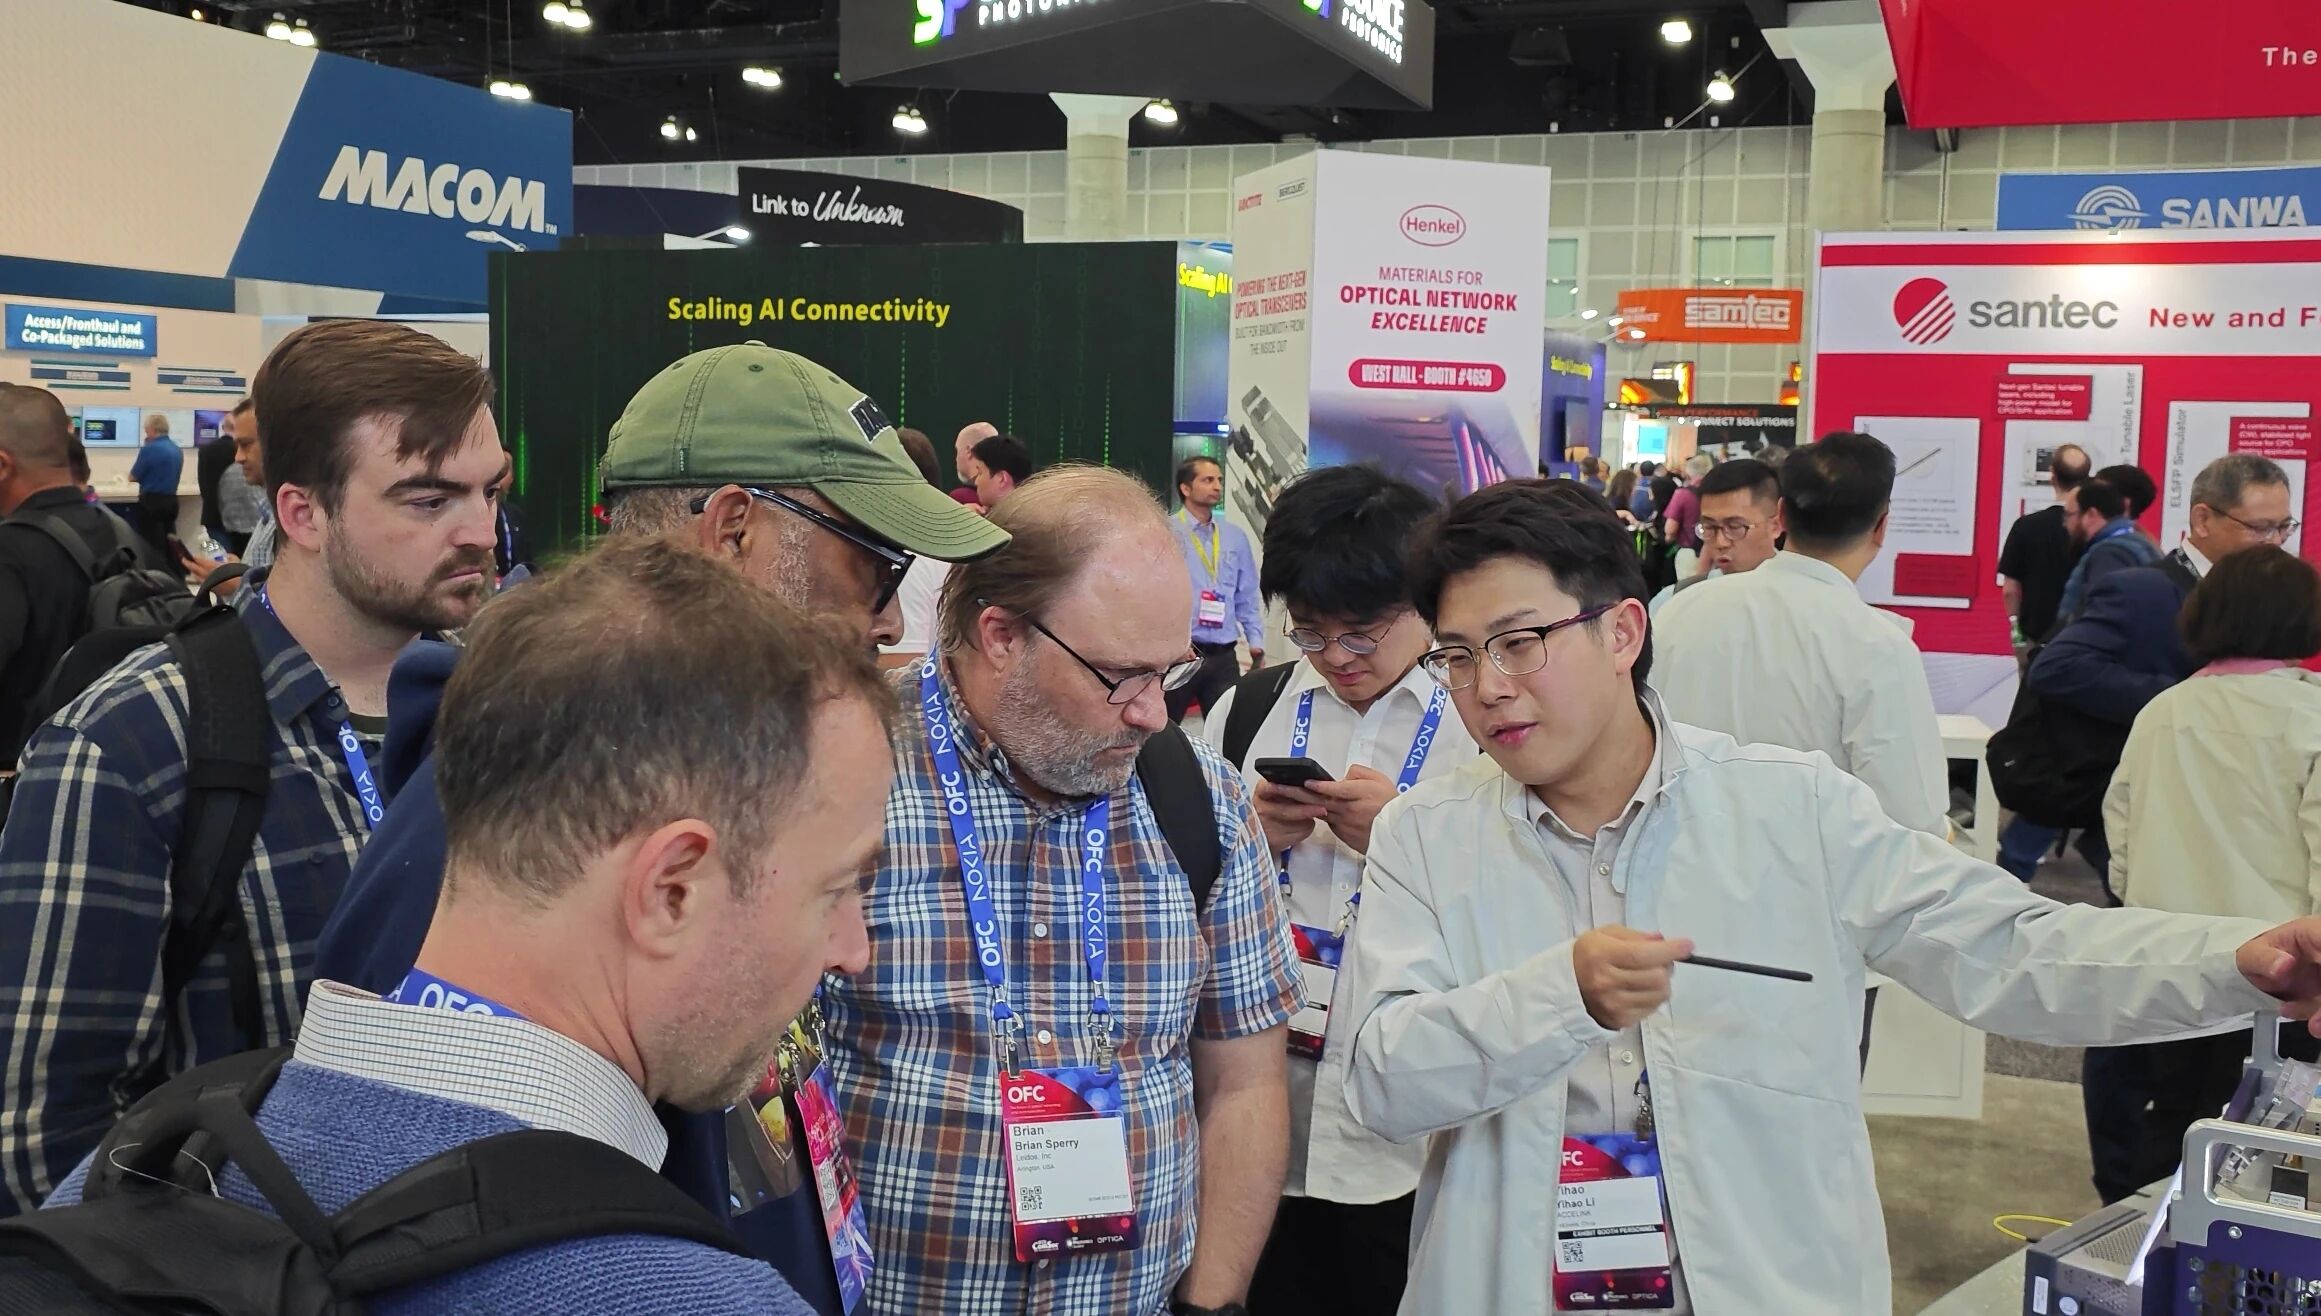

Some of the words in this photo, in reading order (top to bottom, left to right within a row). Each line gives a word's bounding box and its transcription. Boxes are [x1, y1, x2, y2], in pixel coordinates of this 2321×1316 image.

[1341, 6, 1402, 64] PHOTONICS
[2262, 46, 2319, 67] The
[318, 144, 545, 233] MACOM
[752, 193, 788, 215] Link
[791, 198, 809, 217] to
[812, 185, 905, 227] Unknown
[2161, 195, 2307, 229] SANWA
[1406, 216, 1460, 234] Henkel
[1379, 266, 1453, 284] MATERIALS
[1457, 270, 1483, 286] FOR
[1340, 285, 1421, 306] OPTICAL
[1426, 289, 1518, 311] NETWORK
[1968, 294, 2119, 328] santec
[24, 313, 119, 334] Access/Fronthaul
[121, 321, 141, 336] and
[668, 297, 752, 326] Scaling
[759, 298, 784, 320] AI
[790, 298, 950, 328] Connectivity
[1371, 311, 1488, 334] EXCELLENCE
[1685, 295, 1791, 330] samtec
[2150, 308, 2215, 328] New
[2228, 307, 2285, 328] and
[2300, 307, 2321, 327] F
[22, 328, 93, 349] Co-Packaged
[95, 333, 145, 350] Solutions
[1362, 364, 1392, 383] WEST
[1392, 365, 1418, 384] HALL
[1423, 366, 1457, 385] BOOTH
[1736, 416, 1795, 427] SOLUTIONS
[1430, 687, 1447, 717] OFC
[1293, 717, 1309, 748] OFC
[1406, 724, 1434, 769] NOKIA
[926, 691, 952, 755] NOKIA
[941, 770, 968, 816] OFC
[358, 770, 384, 822] OKIA
[1085, 828, 1105, 874] OFC
[959, 833, 987, 902] NOKIA
[975, 919, 1001, 967] OFC
[1086, 892, 1105, 959] NOKIA
[1007, 1085, 1046, 1103] OFC
[1013, 1126, 1044, 1137] Brian
[1015, 1141, 1043, 1151] Brian
[1045, 1139, 1079, 1150] Sperry
[1561, 1150, 1584, 1167] FC
[1097, 1235, 1124, 1244] OPTICA
